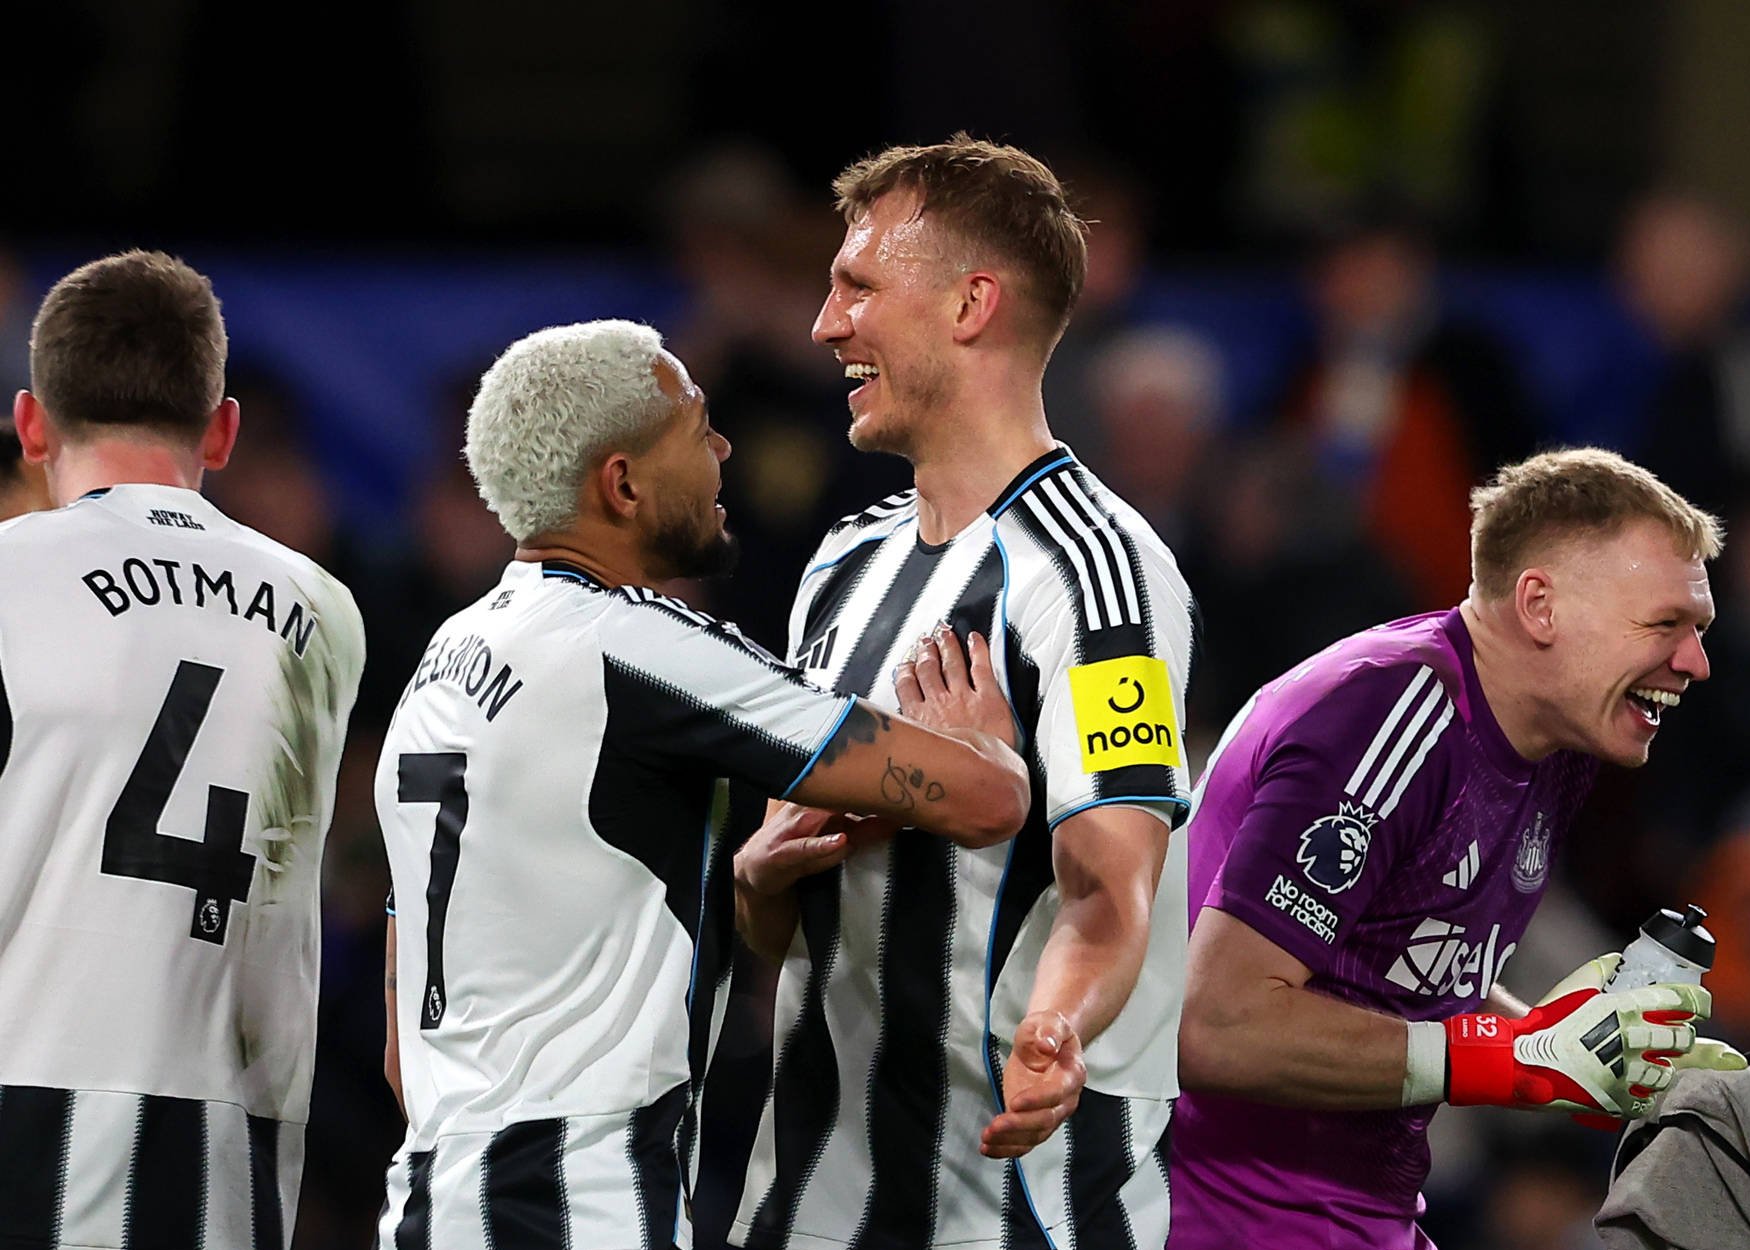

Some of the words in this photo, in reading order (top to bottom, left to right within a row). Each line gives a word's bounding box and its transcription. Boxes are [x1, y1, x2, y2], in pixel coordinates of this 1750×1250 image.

[146, 516, 174, 527] THE
[149, 509, 193, 521] HOWAY
[82, 558, 317, 659] BOTMAN
[1087, 722, 1172, 755] noon
[101, 659, 256, 946] 4
[398, 752, 469, 1030] 7
[1272, 874, 1299, 900] No
[1298, 893, 1339, 929] room
[1289, 904, 1336, 945] racism
[1475, 1015, 1498, 1038] 32
